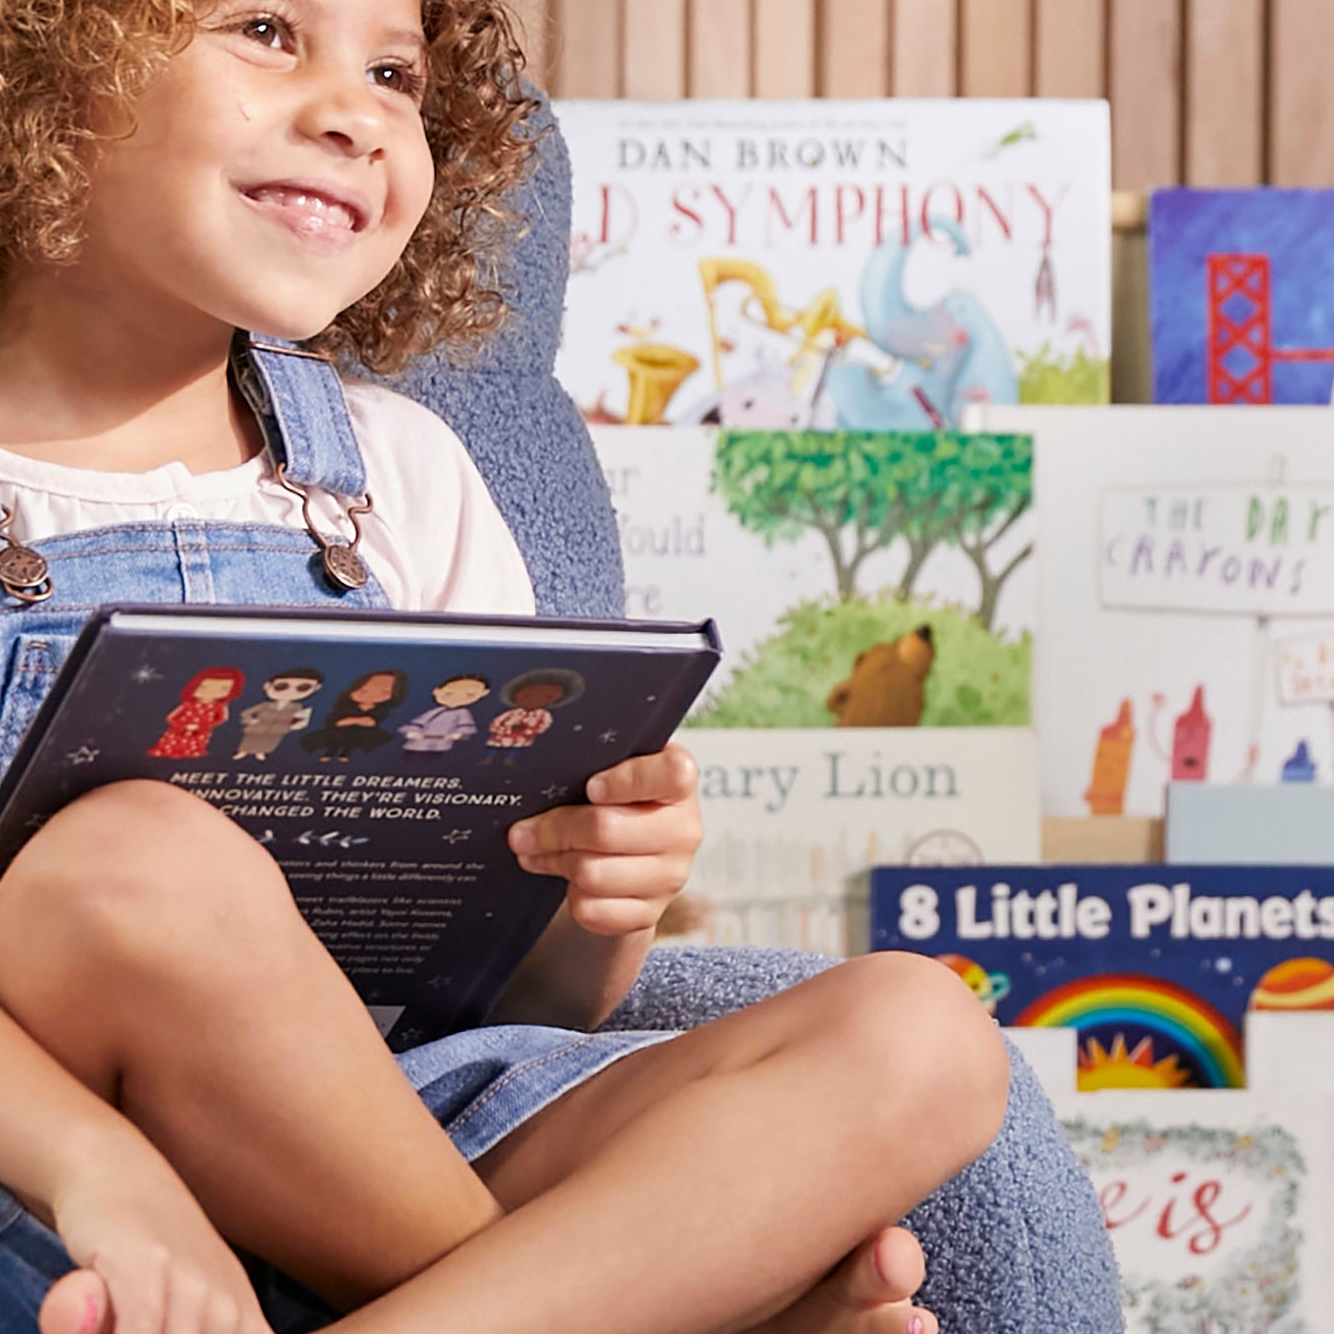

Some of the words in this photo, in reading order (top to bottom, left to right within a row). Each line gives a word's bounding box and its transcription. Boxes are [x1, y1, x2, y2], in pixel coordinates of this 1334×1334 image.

[618, 138, 711, 169] DAN
[736, 138, 907, 169] BROWN
[667, 180, 1068, 247] SYMPHONY
[620, 512, 706, 556] ould
[1144, 496, 1212, 530] THE
[1245, 493, 1333, 545] DAY
[1105, 533, 1307, 595] CRAYONS
[170, 771, 229, 784] MEET
[236, 772, 277, 785] THE
[281, 773, 348, 787] LITTLE
[351, 775, 463, 790] DREAMERS.
[320, 789, 407, 804] THEY'RE
[413, 792, 522, 807] VISIONARY.
[823, 750, 961, 800] Lion
[219, 804, 314, 818] CHANGED
[322, 805, 363, 818] THE
[369, 807, 442, 820] WORLD.
[314, 859, 338, 868] and
[340, 859, 386, 869] thinkers
[389, 860, 418, 870] from
[421, 861, 464, 870] around
[898, 883, 940, 940] 8
[956, 882, 1111, 940] Little
[1155, 1170, 1254, 1256] is
